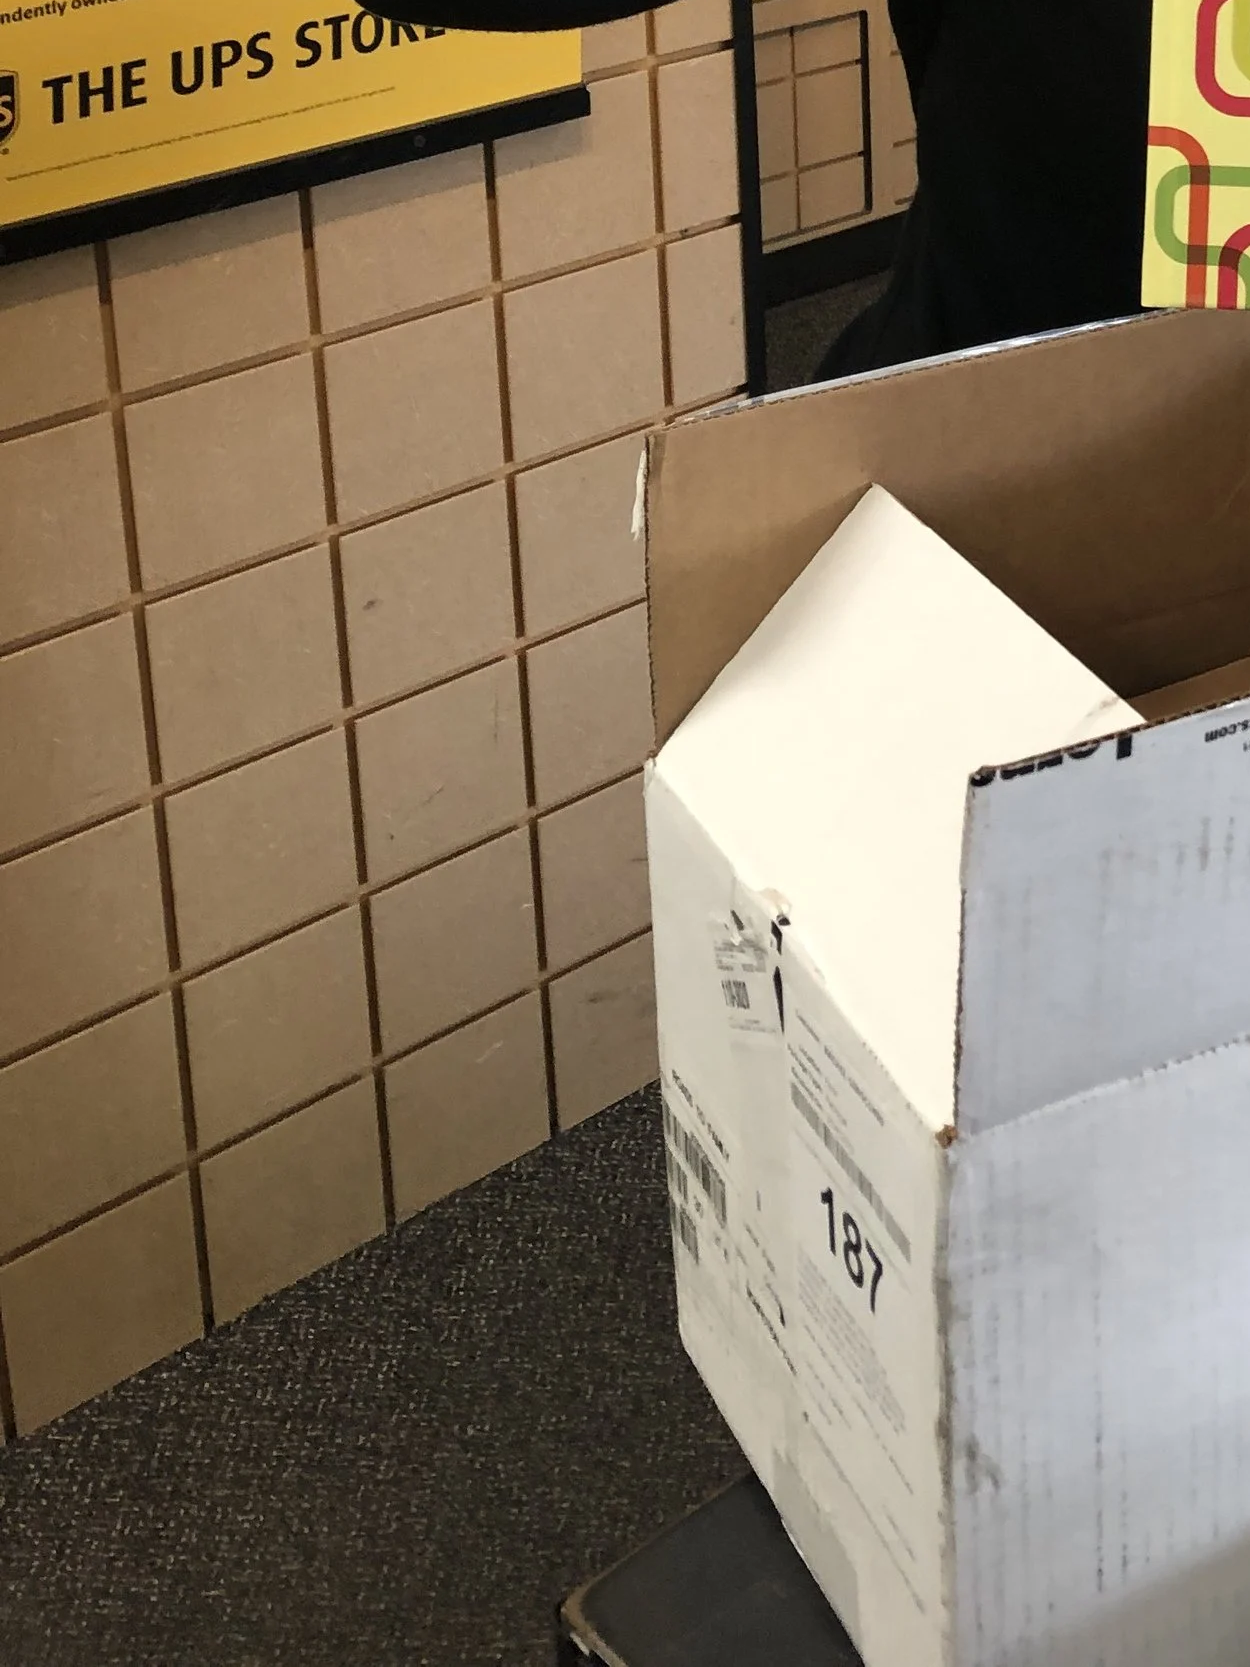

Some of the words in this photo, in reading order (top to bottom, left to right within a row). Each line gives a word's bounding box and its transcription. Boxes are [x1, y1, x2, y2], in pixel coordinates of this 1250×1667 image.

[42, 58, 148, 124] THE
[171, 31, 274, 95] UPS
[295, 10, 447, 69] STO
[820, 1186, 884, 1314] 187
